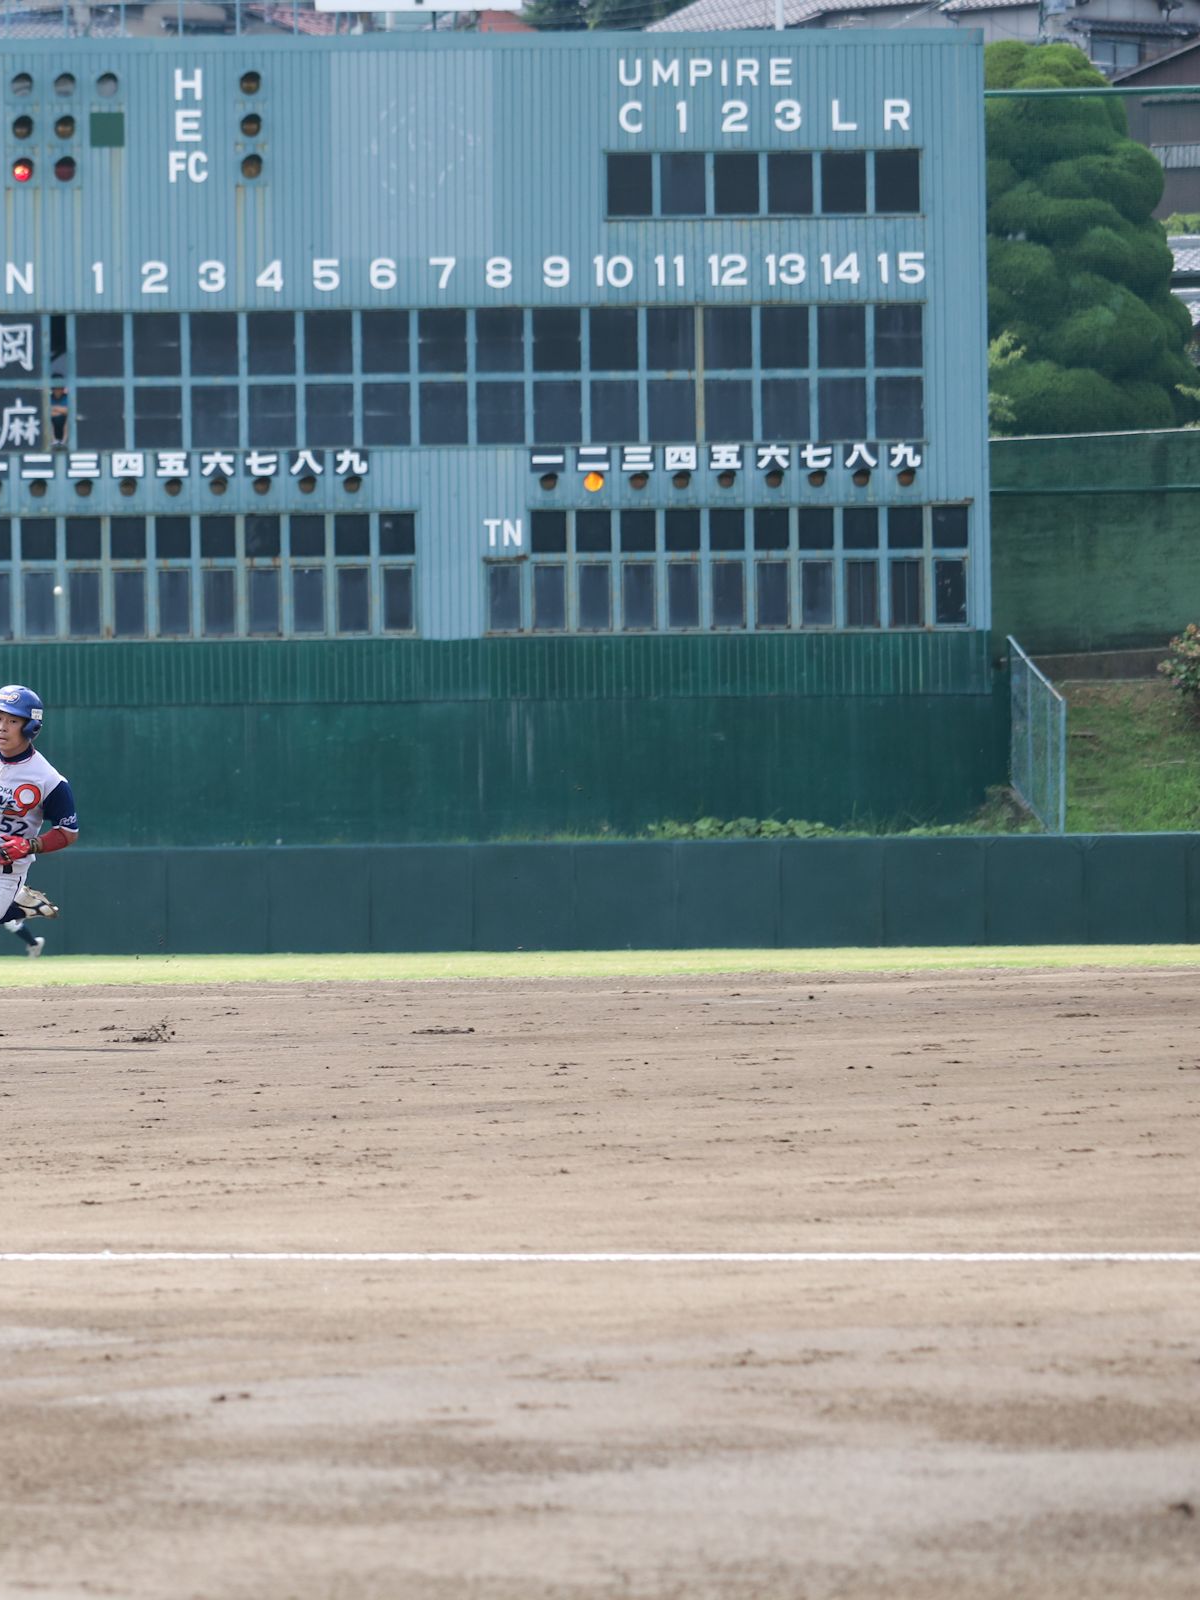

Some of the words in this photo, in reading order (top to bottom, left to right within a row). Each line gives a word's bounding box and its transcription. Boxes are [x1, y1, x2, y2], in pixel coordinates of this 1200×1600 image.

[174, 68, 202, 100] H
[619, 58, 793, 86] UMPIRE
[175, 109, 202, 142] E
[619, 101, 642, 133] C
[675, 101, 687, 133] 1
[721, 100, 748, 132] 2
[774, 99, 801, 132] 3
[831, 99, 857, 131] L
[884, 99, 911, 131] R
[169, 151, 208, 183] FC
[91, 261, 103, 294] 1
[141, 261, 168, 293] 2
[198, 260, 226, 292] 3
[256, 260, 283, 292] 4
[313, 258, 340, 291] 5
[370, 257, 397, 290] 6
[429, 256, 456, 289] 7
[486, 256, 512, 289] 8
[543, 256, 570, 288] 9
[593, 255, 633, 288] 10
[654, 255, 685, 286] 11
[708, 254, 748, 286] 12
[765, 253, 806, 285] 13
[820, 252, 860, 285] 14
[877, 252, 925, 284] 15
[22, 454, 54, 478] 二
[68, 453, 100, 477] 三
[112, 453, 144, 477] 四
[157, 452, 188, 476] 五
[202, 451, 234, 476] 六
[245, 451, 277, 475] 七
[291, 451, 322, 474] 八
[336, 450, 367, 474] 九
[578, 447, 609, 471] 二
[622, 446, 654, 470] 三
[665, 446, 696, 470] 四
[710, 445, 741, 469] 五
[757, 444, 789, 468] 六
[801, 444, 832, 468] 七
[845, 444, 877, 467] 八
[890, 444, 921, 467] 九
[482, 518, 522, 547] TN
